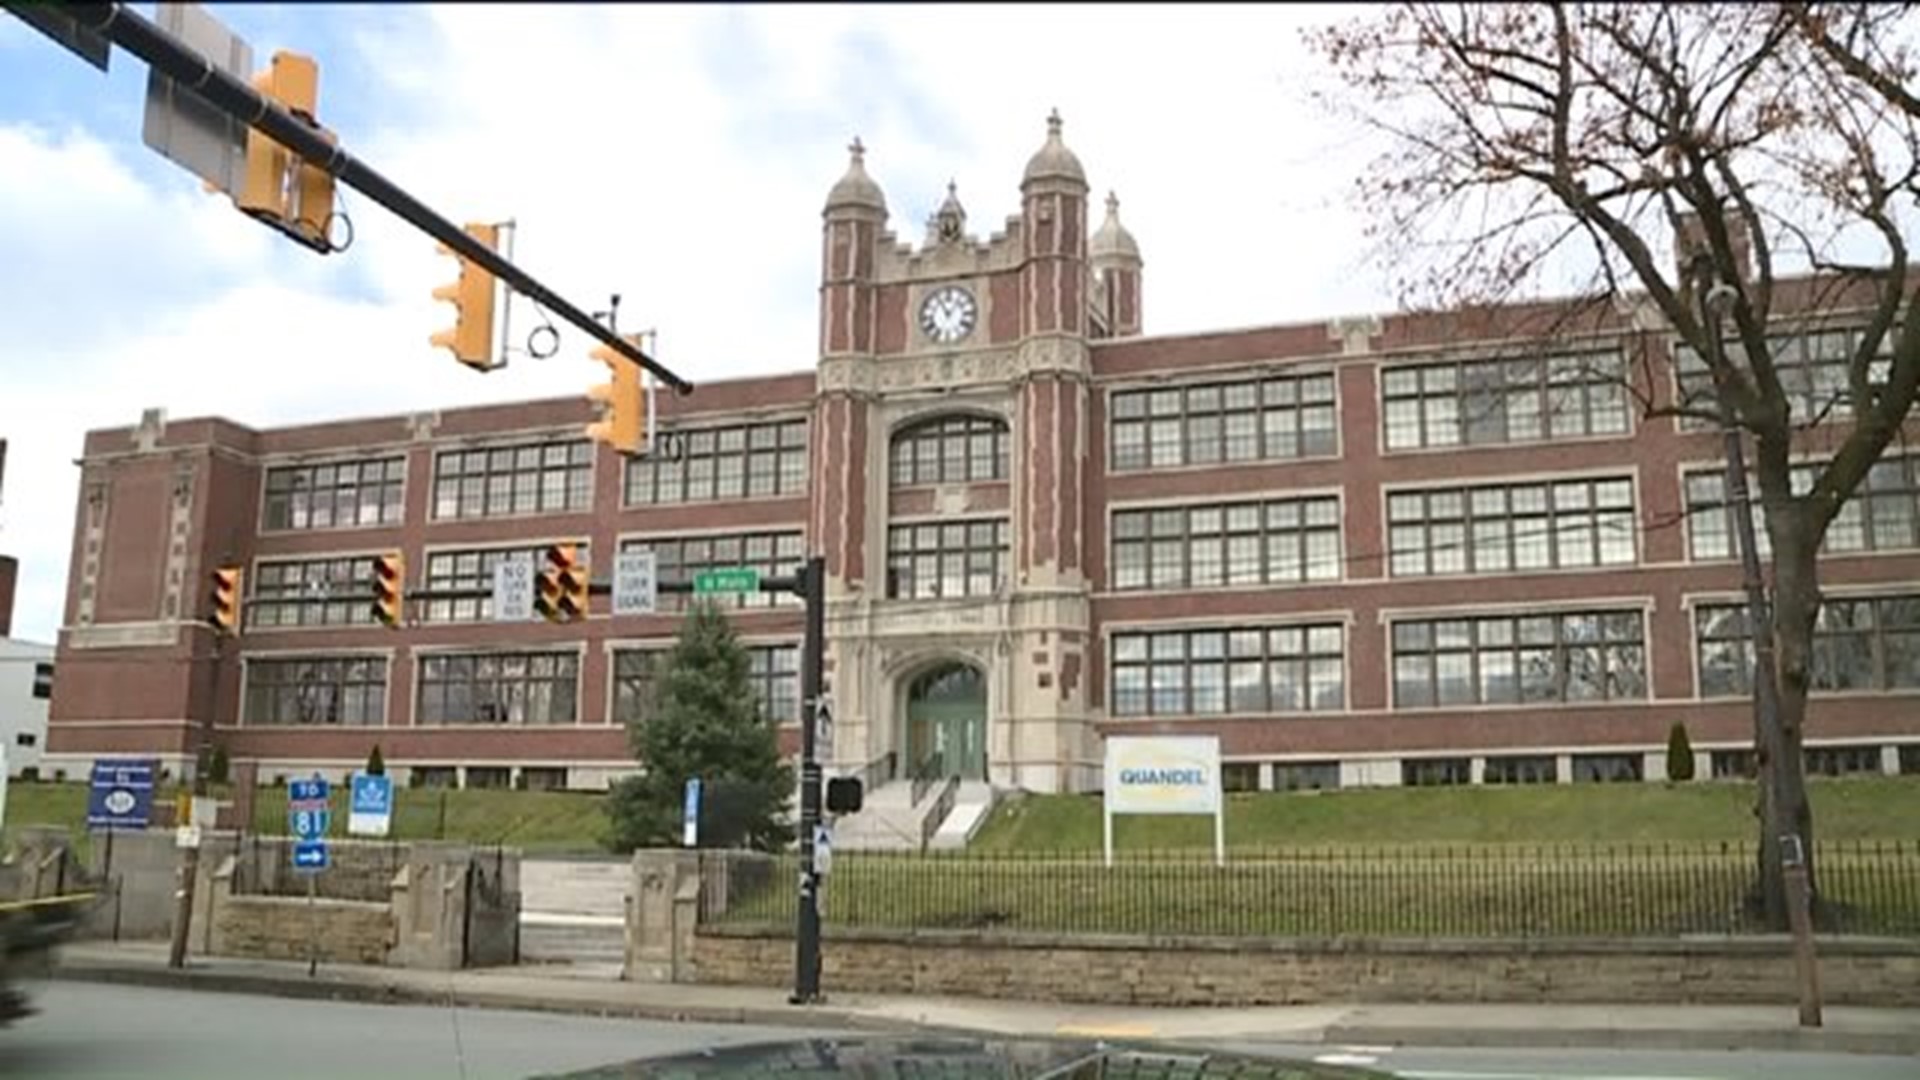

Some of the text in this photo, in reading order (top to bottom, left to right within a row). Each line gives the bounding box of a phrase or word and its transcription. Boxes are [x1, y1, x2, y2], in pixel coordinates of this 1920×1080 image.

[503, 564, 527, 578] NO
[1120, 768, 1206, 785] QUANDEL
[299, 783, 319, 797] TO
[296, 811, 321, 835] 81
